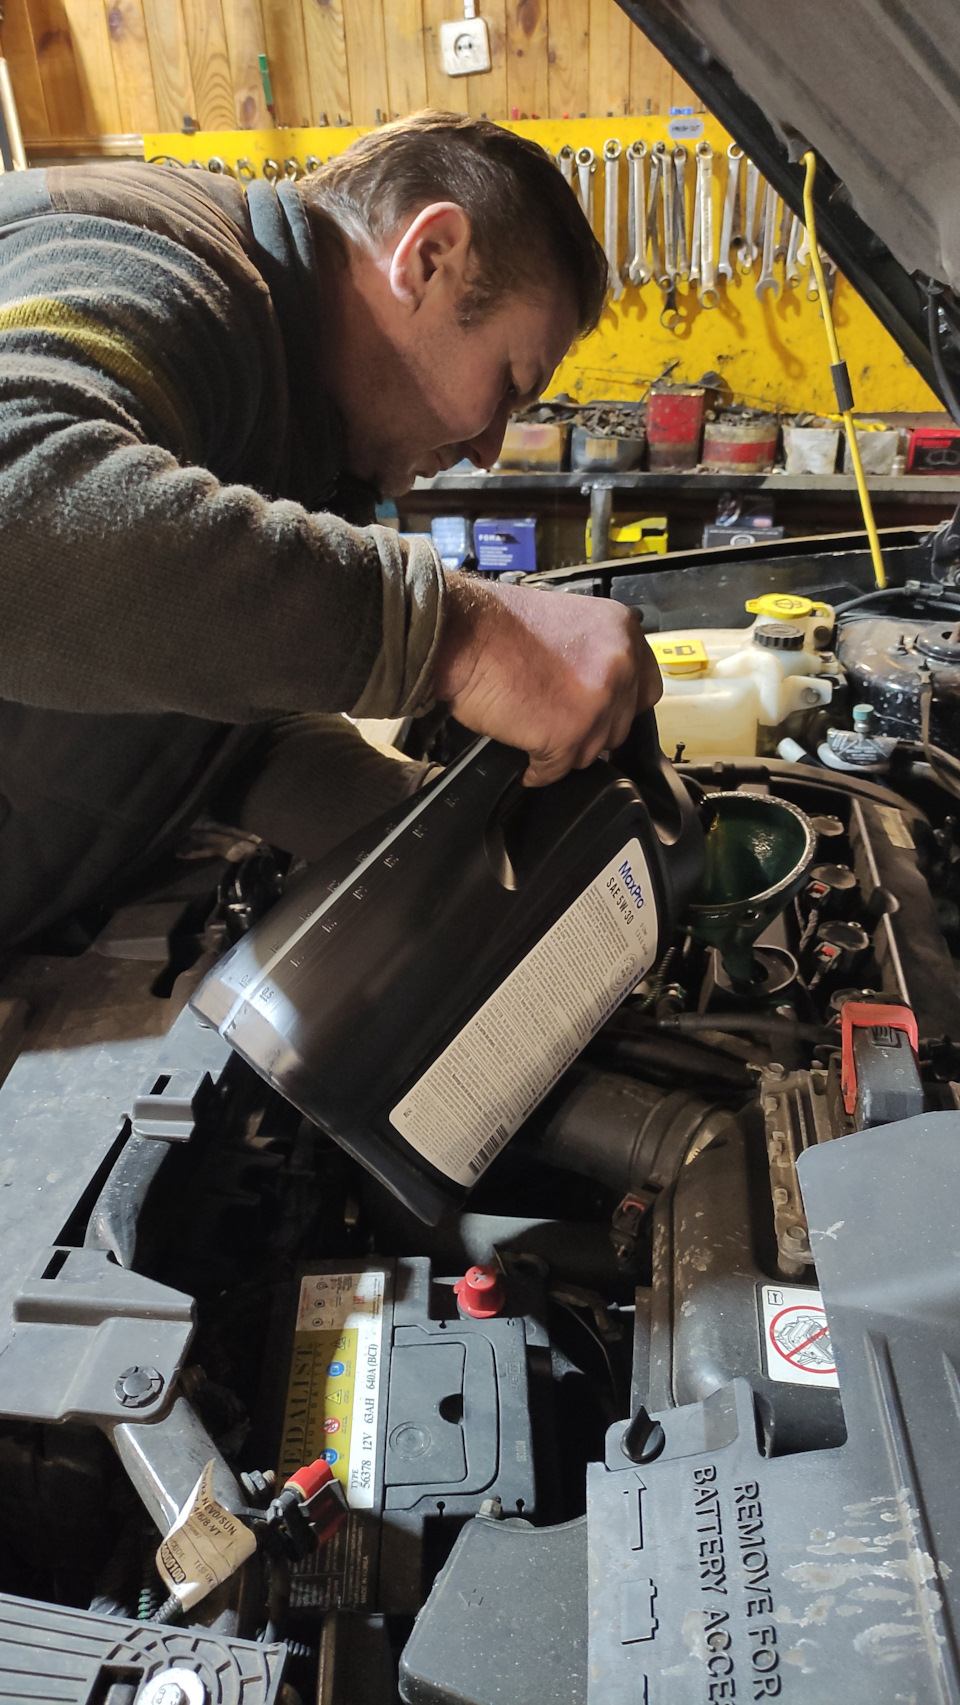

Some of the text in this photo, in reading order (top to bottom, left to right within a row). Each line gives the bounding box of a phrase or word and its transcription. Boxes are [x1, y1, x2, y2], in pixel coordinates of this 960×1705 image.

[618, 860, 646, 910] MaxPro
[606, 877, 634, 925] SAE 5W-30
[261, 986, 274, 1000] 0.5
[365, 1367, 377, 1390] 640A
[364, 1398, 375, 1424] 63AH
[362, 1432, 373, 1451] 12V
[350, 1468, 359, 1490] TYPE
[360, 1459, 372, 1489] 56378
[693, 1465, 737, 1705] BATTERY ACCE
[734, 1481, 782, 1701] REMOVE FOR
